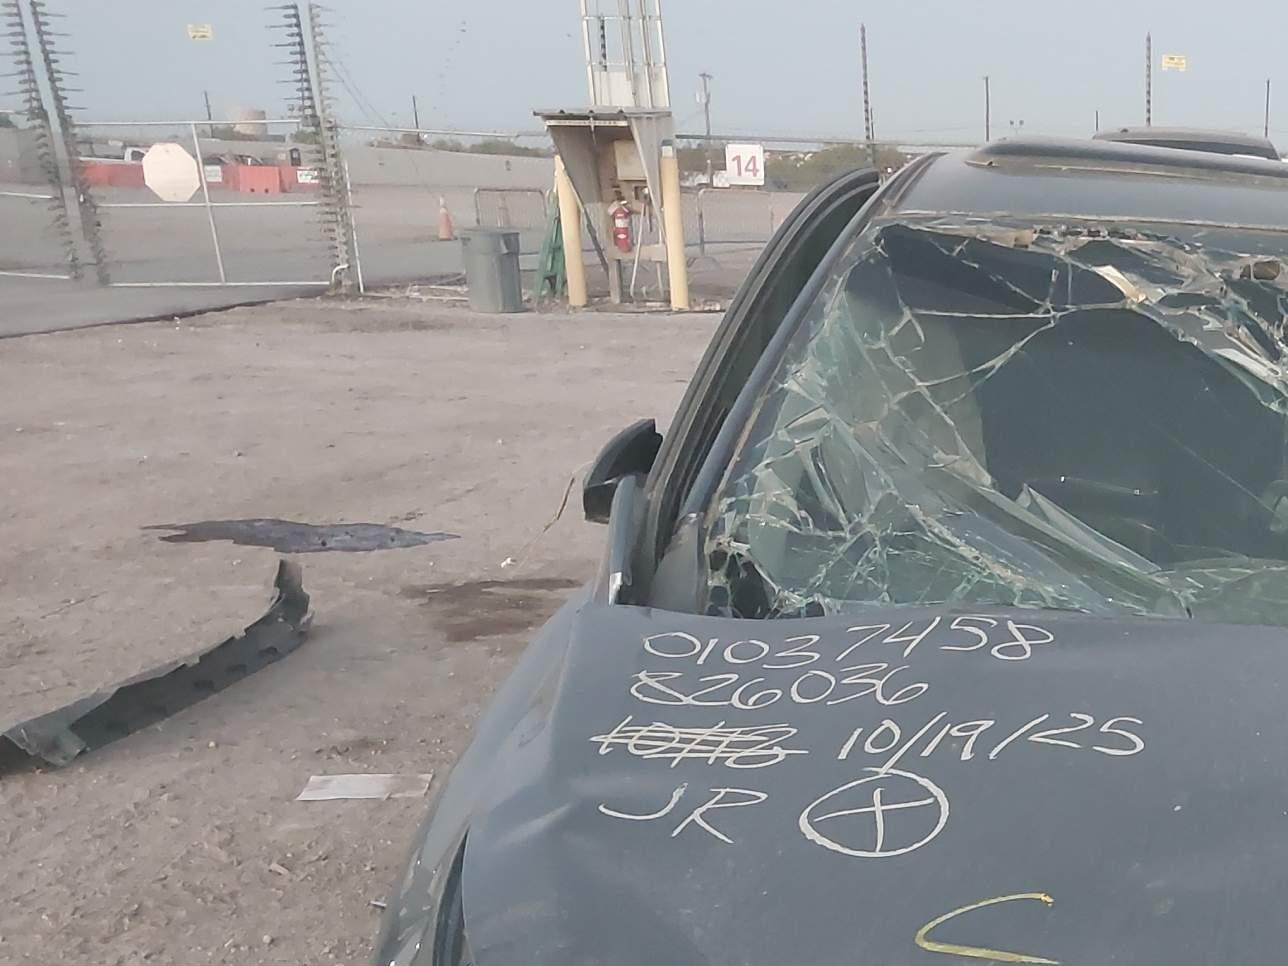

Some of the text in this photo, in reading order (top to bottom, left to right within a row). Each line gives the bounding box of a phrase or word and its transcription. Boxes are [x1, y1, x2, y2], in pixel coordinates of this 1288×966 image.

[731, 155, 760, 178] 14
[643, 616, 1054, 669] 01037458
[630, 662, 930, 709] 826036
[837, 712, 1146, 774] 10/19/25
[598, 782, 769, 844] JR
